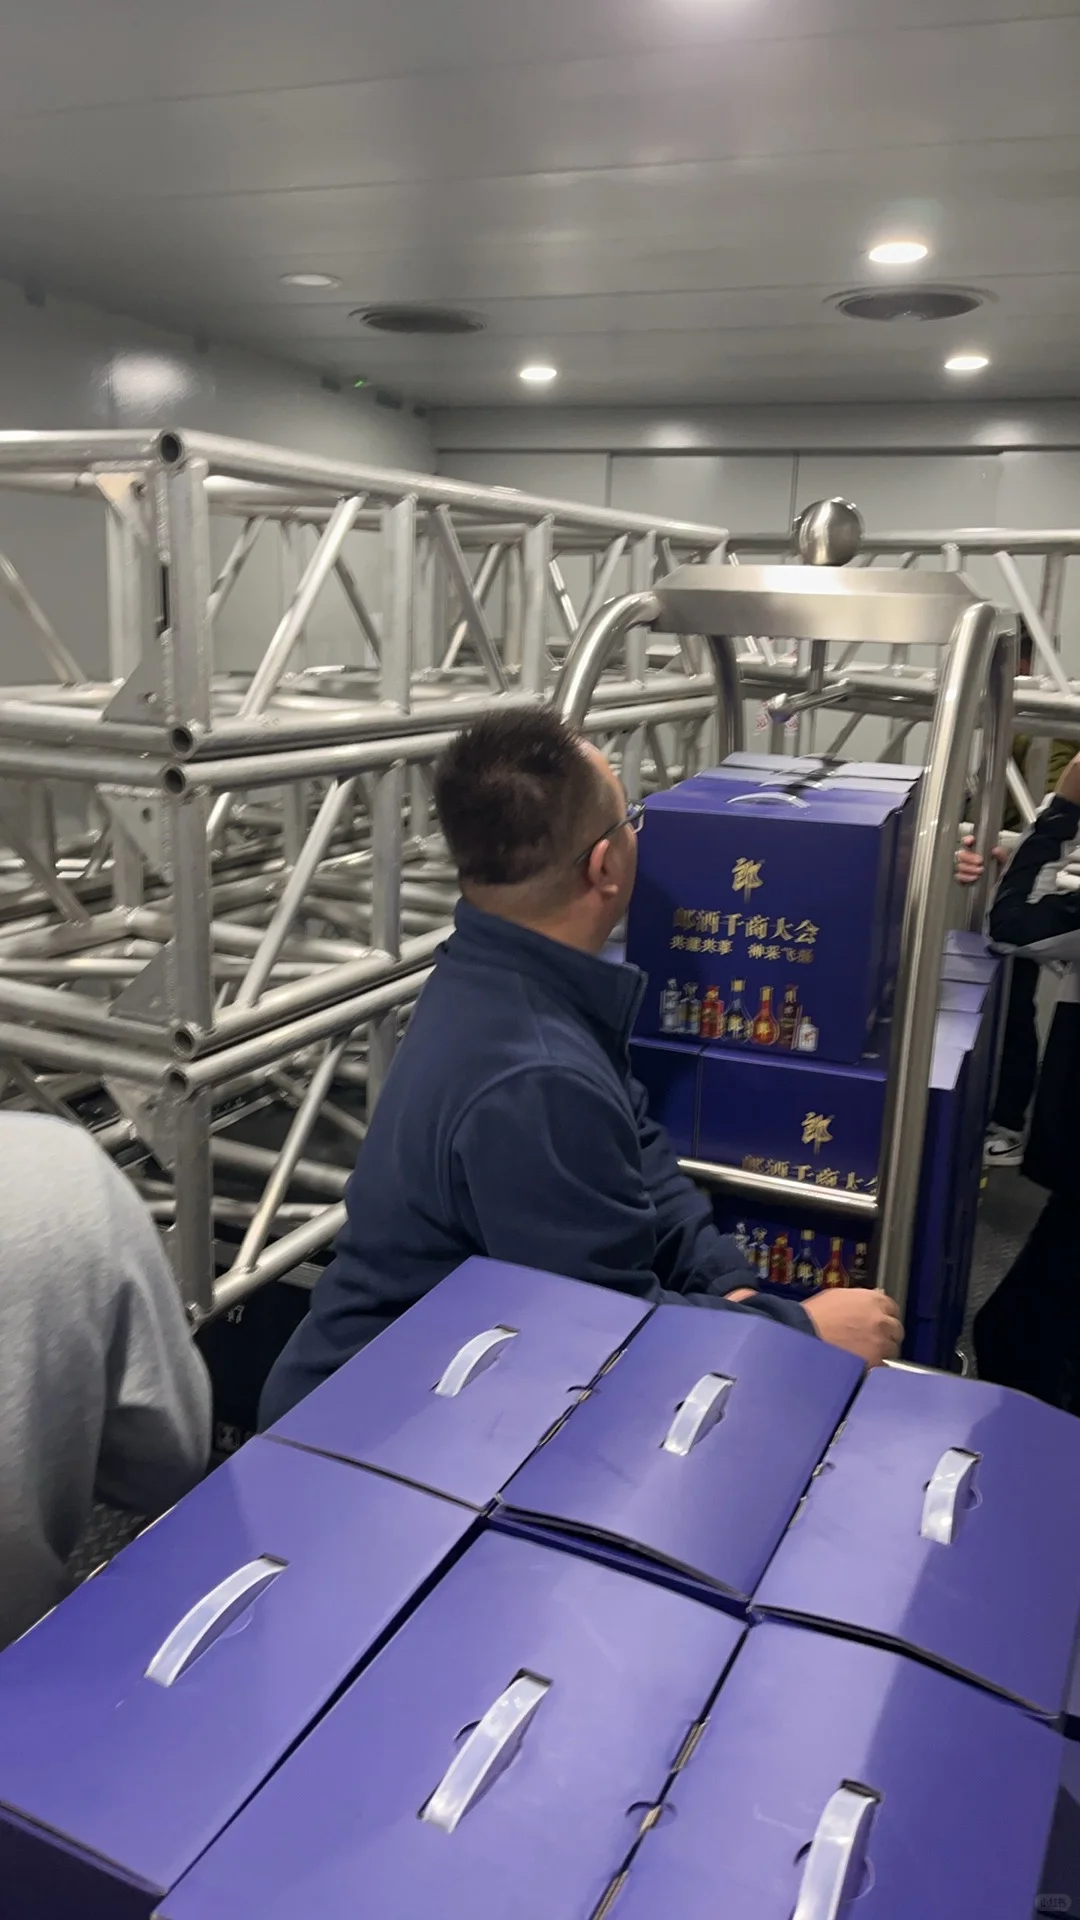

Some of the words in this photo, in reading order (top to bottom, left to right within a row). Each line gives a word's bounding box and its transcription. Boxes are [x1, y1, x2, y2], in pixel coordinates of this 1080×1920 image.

[732, 857, 766, 903] 郎
[673, 907, 820, 945] 郎酒千商大会
[801, 1111, 835, 1155] 郎
